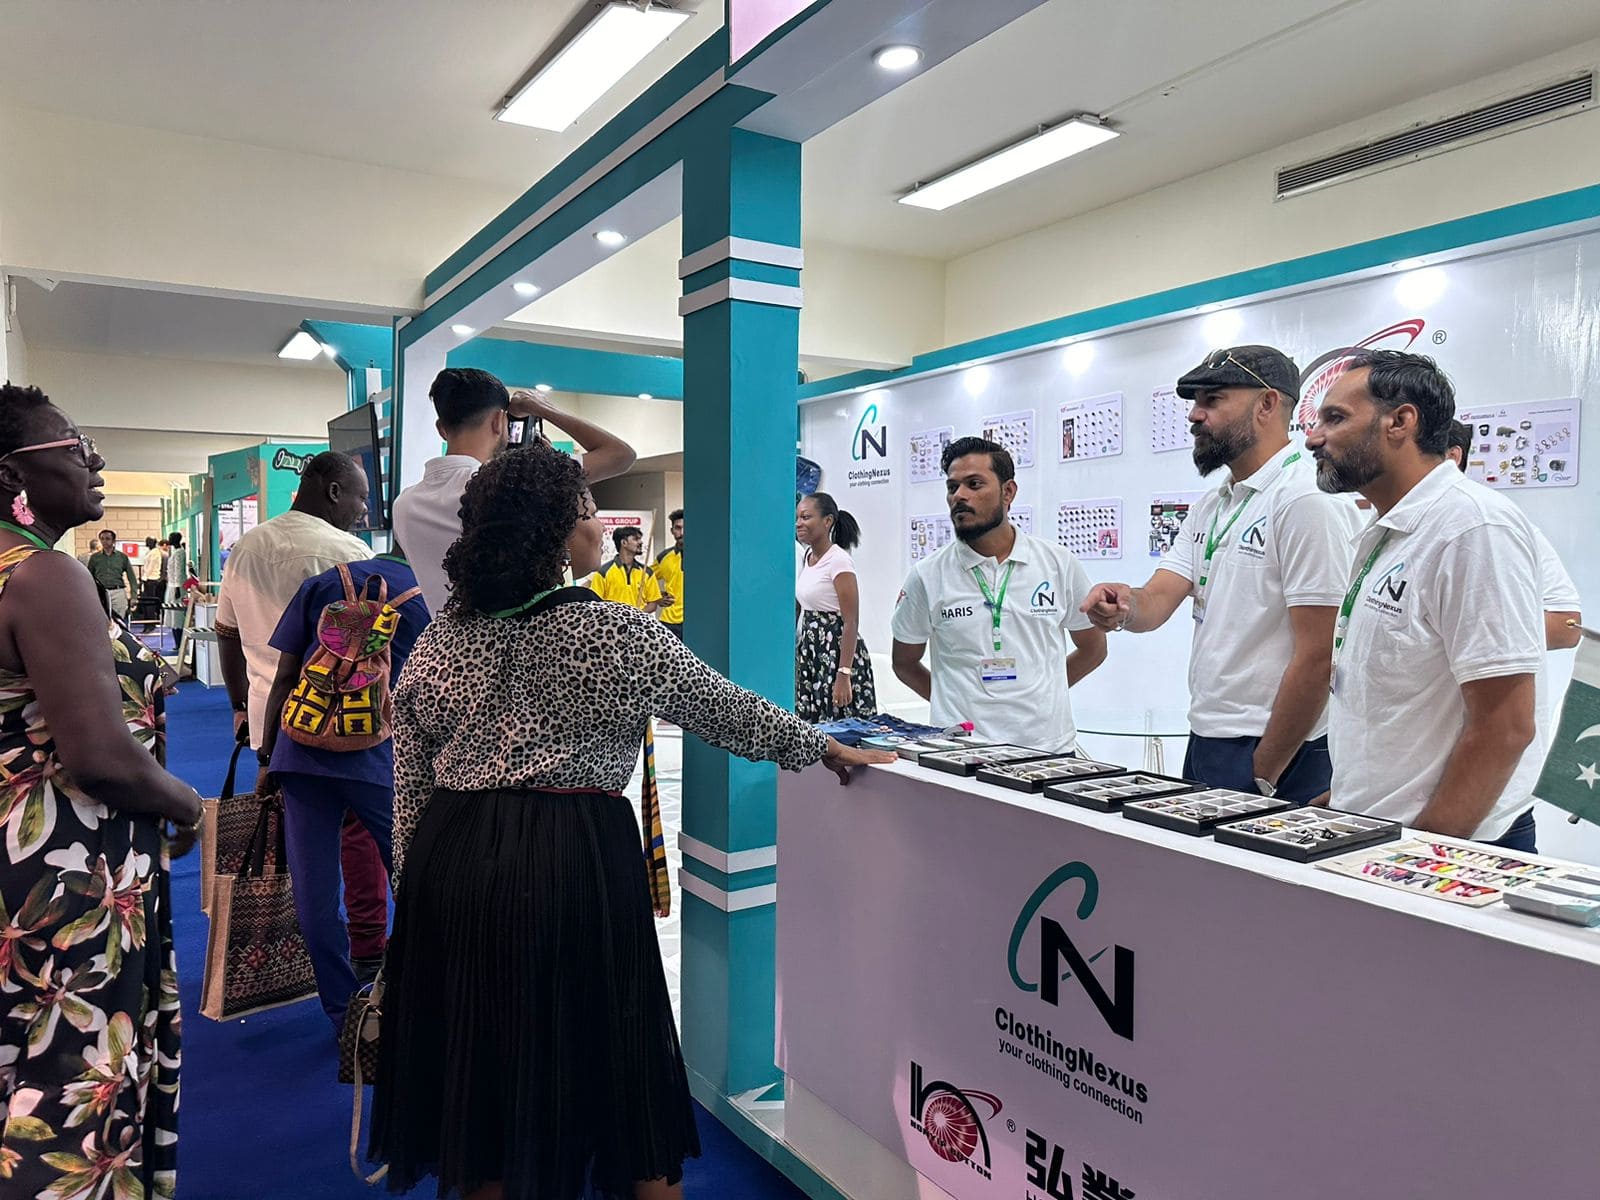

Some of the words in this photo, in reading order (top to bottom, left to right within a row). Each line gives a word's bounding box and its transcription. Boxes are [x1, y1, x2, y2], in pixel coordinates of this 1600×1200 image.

[848, 468, 891, 480] ClothingNexus
[941, 606, 974, 619] HARIS
[994, 1006, 1149, 1103] ClothingNexus
[998, 1037, 1023, 1060] your
[1025, 1049, 1071, 1089] clothing
[1073, 1076, 1143, 1124] connection
[950, 1146, 992, 1181] BUTTON
